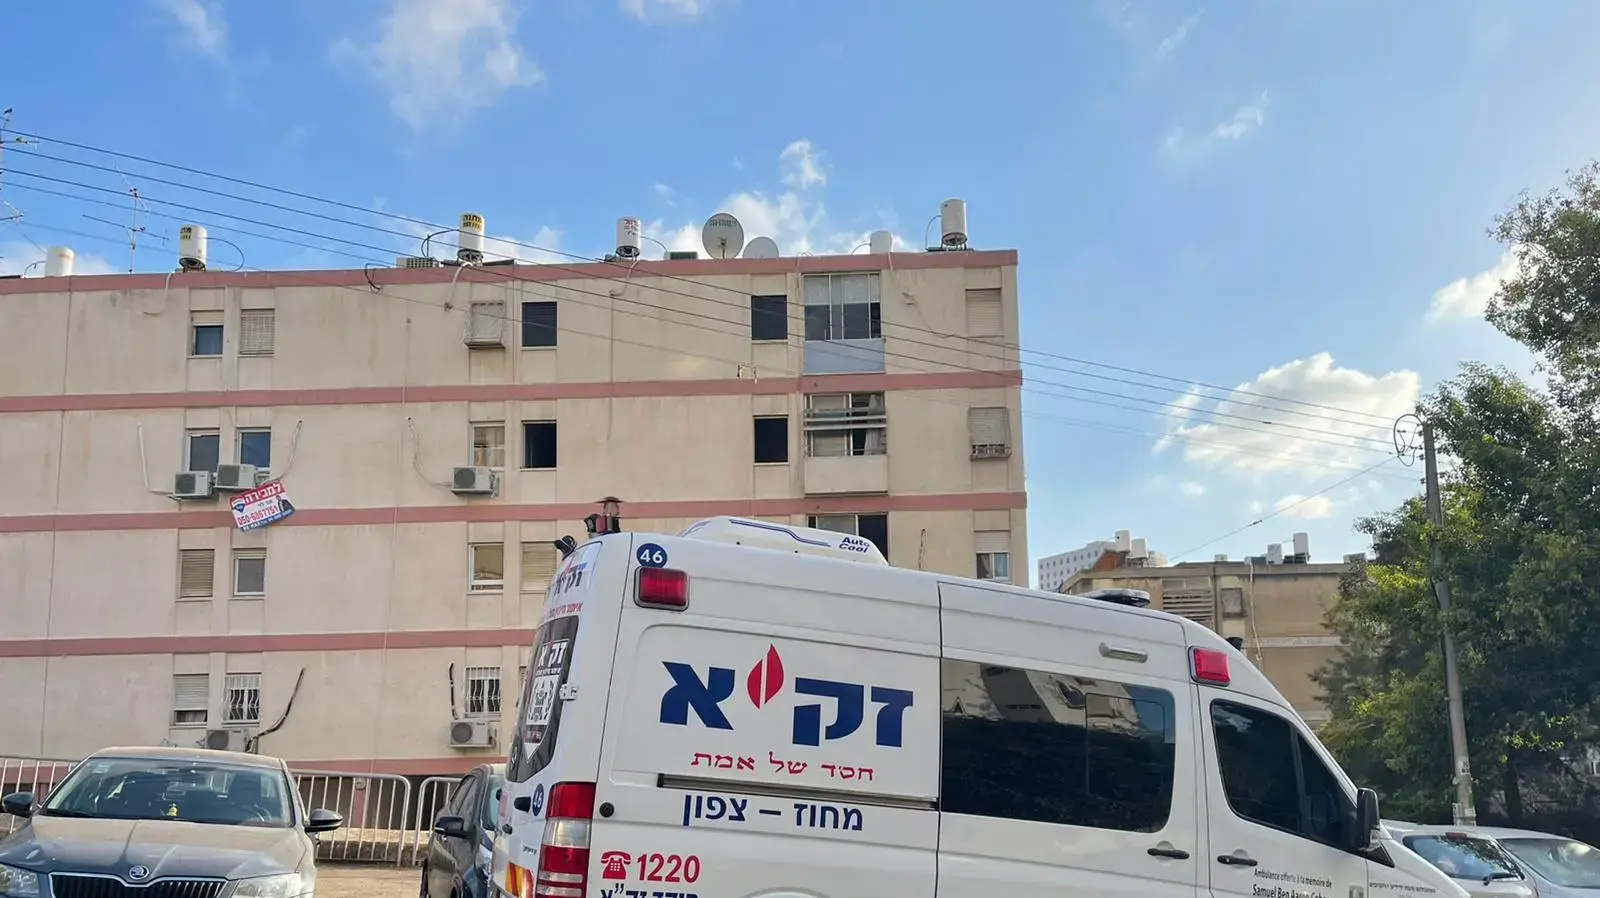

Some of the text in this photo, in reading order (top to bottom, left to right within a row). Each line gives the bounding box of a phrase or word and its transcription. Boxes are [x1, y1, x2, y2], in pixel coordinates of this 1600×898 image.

[244, 483, 281, 503] למכירה
[839, 543, 869, 553] Cool
[842, 536, 870, 547] Auto
[639, 549, 663, 564] 46
[691, 751, 875, 782] חסד של אמת
[682, 794, 748, 827] צפון
[793, 803, 863, 832] מחוז
[637, 853, 701, 883] 1220
[1254, 868, 1280, 881] Ambulance
[1325, 878, 1332, 889] de
[1253, 883, 1277, 898] Samuel
[1277, 887, 1290, 898] Ben
